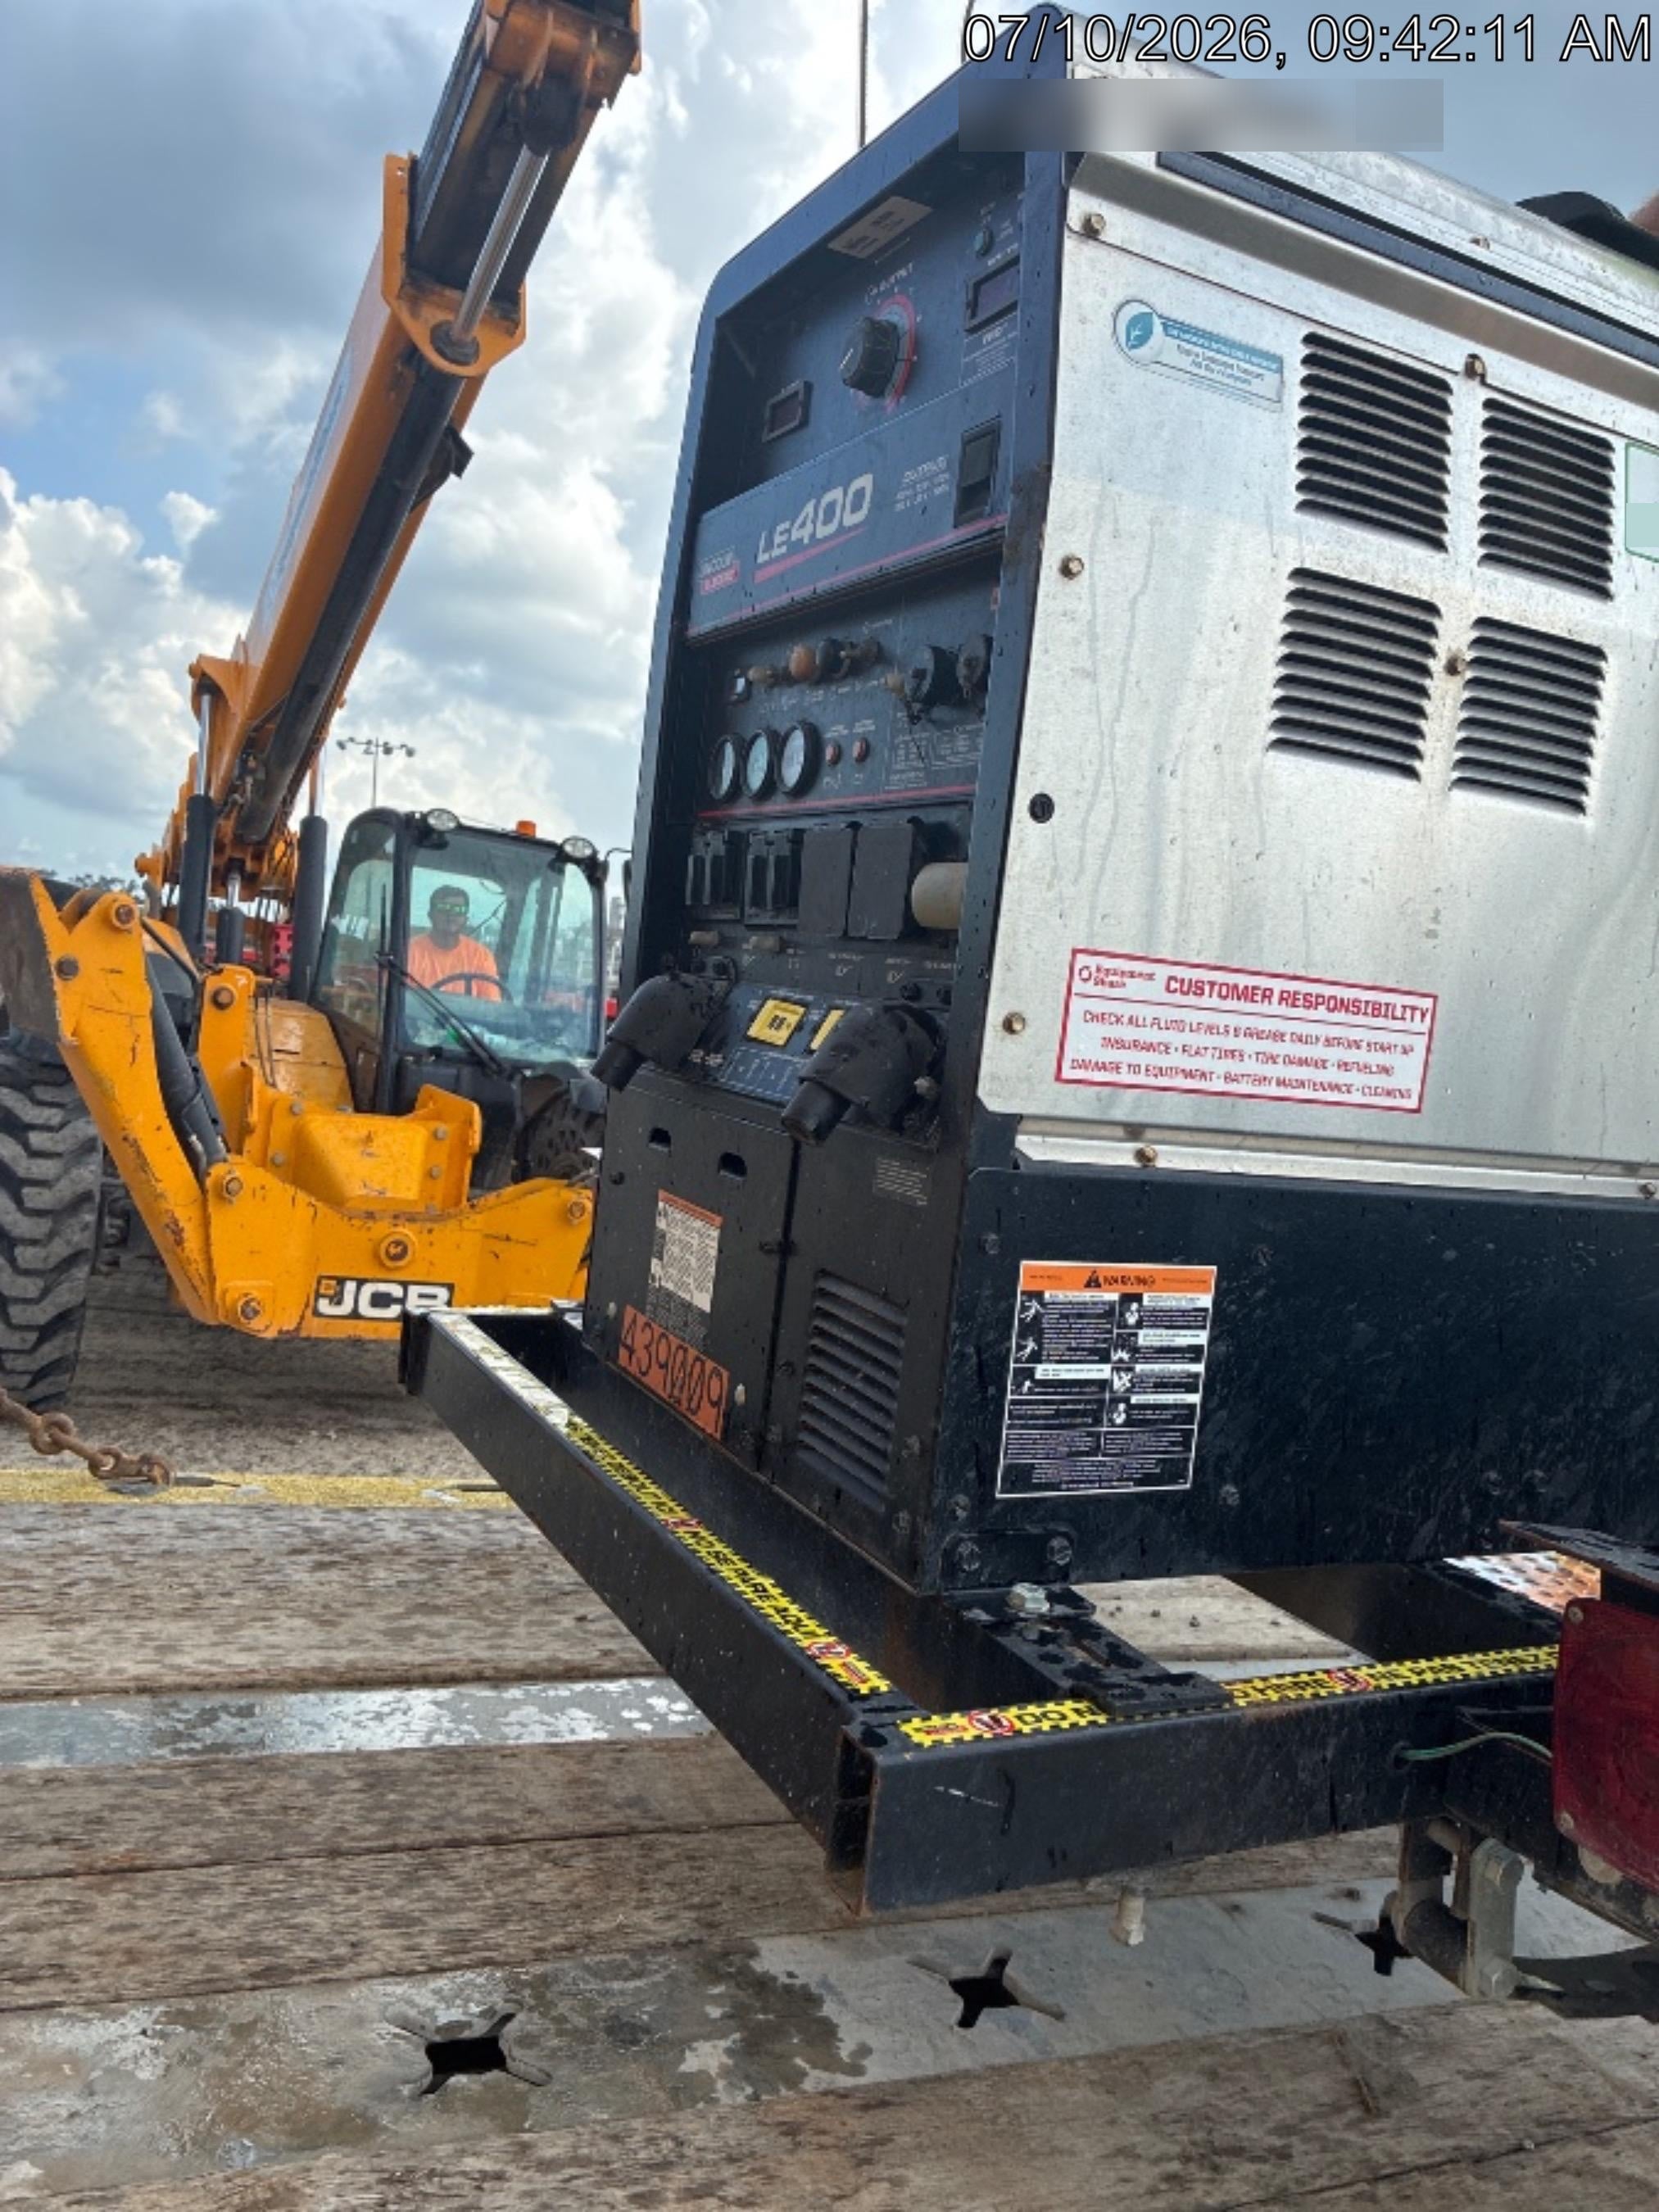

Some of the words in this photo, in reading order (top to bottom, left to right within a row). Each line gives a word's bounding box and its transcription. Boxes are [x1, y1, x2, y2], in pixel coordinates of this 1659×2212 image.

[756, 473, 873, 564] LE400
[1165, 975, 1274, 1004] CUSTOMER
[1278, 989, 1429, 1024] RESPONSIBILITY
[1083, 1009, 1123, 1026] CHECK
[1126, 1015, 1147, 1027] ALL
[1190, 1022, 1230, 1037] LEVELS
[1290, 1034, 1321, 1046] DAILY
[1366, 1040, 1398, 1055] START
[1101, 1036, 1172, 1055] INSURANCE
[1182, 1045, 1209, 1058] FLAT
[1212, 1047, 1245, 1062] TIRES
[1283, 1054, 1330, 1070] DAMAGE
[1337, 1060, 1394, 1077] REFUELING
[1070, 1058, 1122, 1074] DAMAGE
[1126, 1063, 1141, 1075] TO
[1145, 1064, 1214, 1082] EQUIPMENT
[1224, 1072, 1274, 1088] BATTERY
[1276, 1077, 1355, 1095] MAINTENANCE
[1362, 1085, 1412, 1099] CLEANING
[317, 1280, 450, 1318] JCB
[1103, 1275, 1156, 1288] WARNING
